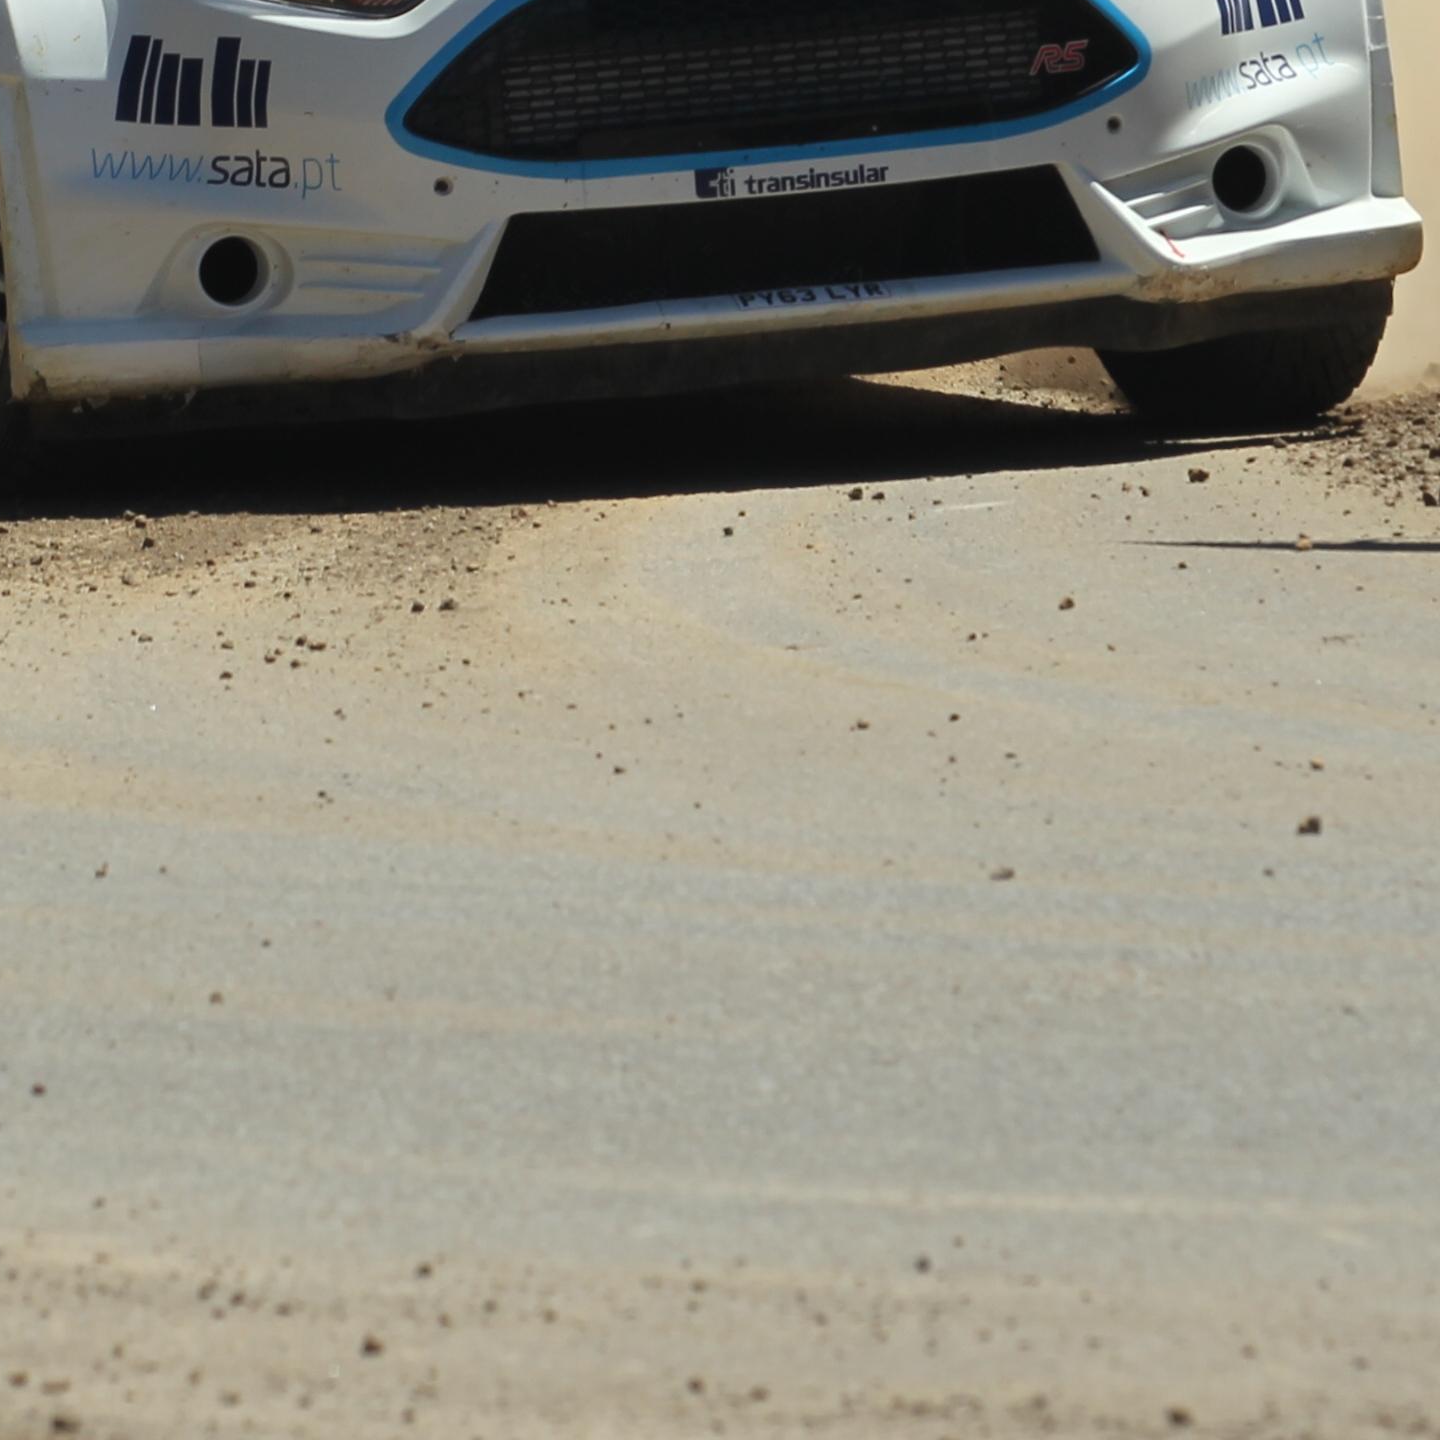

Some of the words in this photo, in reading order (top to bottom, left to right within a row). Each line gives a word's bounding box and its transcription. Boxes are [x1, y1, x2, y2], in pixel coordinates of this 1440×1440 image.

[1028, 38, 1089, 76] RS
[1184, 32, 1336, 110] www.satapt
[91, 147, 343, 201] www.sata.pt
[743, 163, 889, 195] transinsular
[739, 286, 818, 308] PY63
[824, 282, 884, 300] LYR
